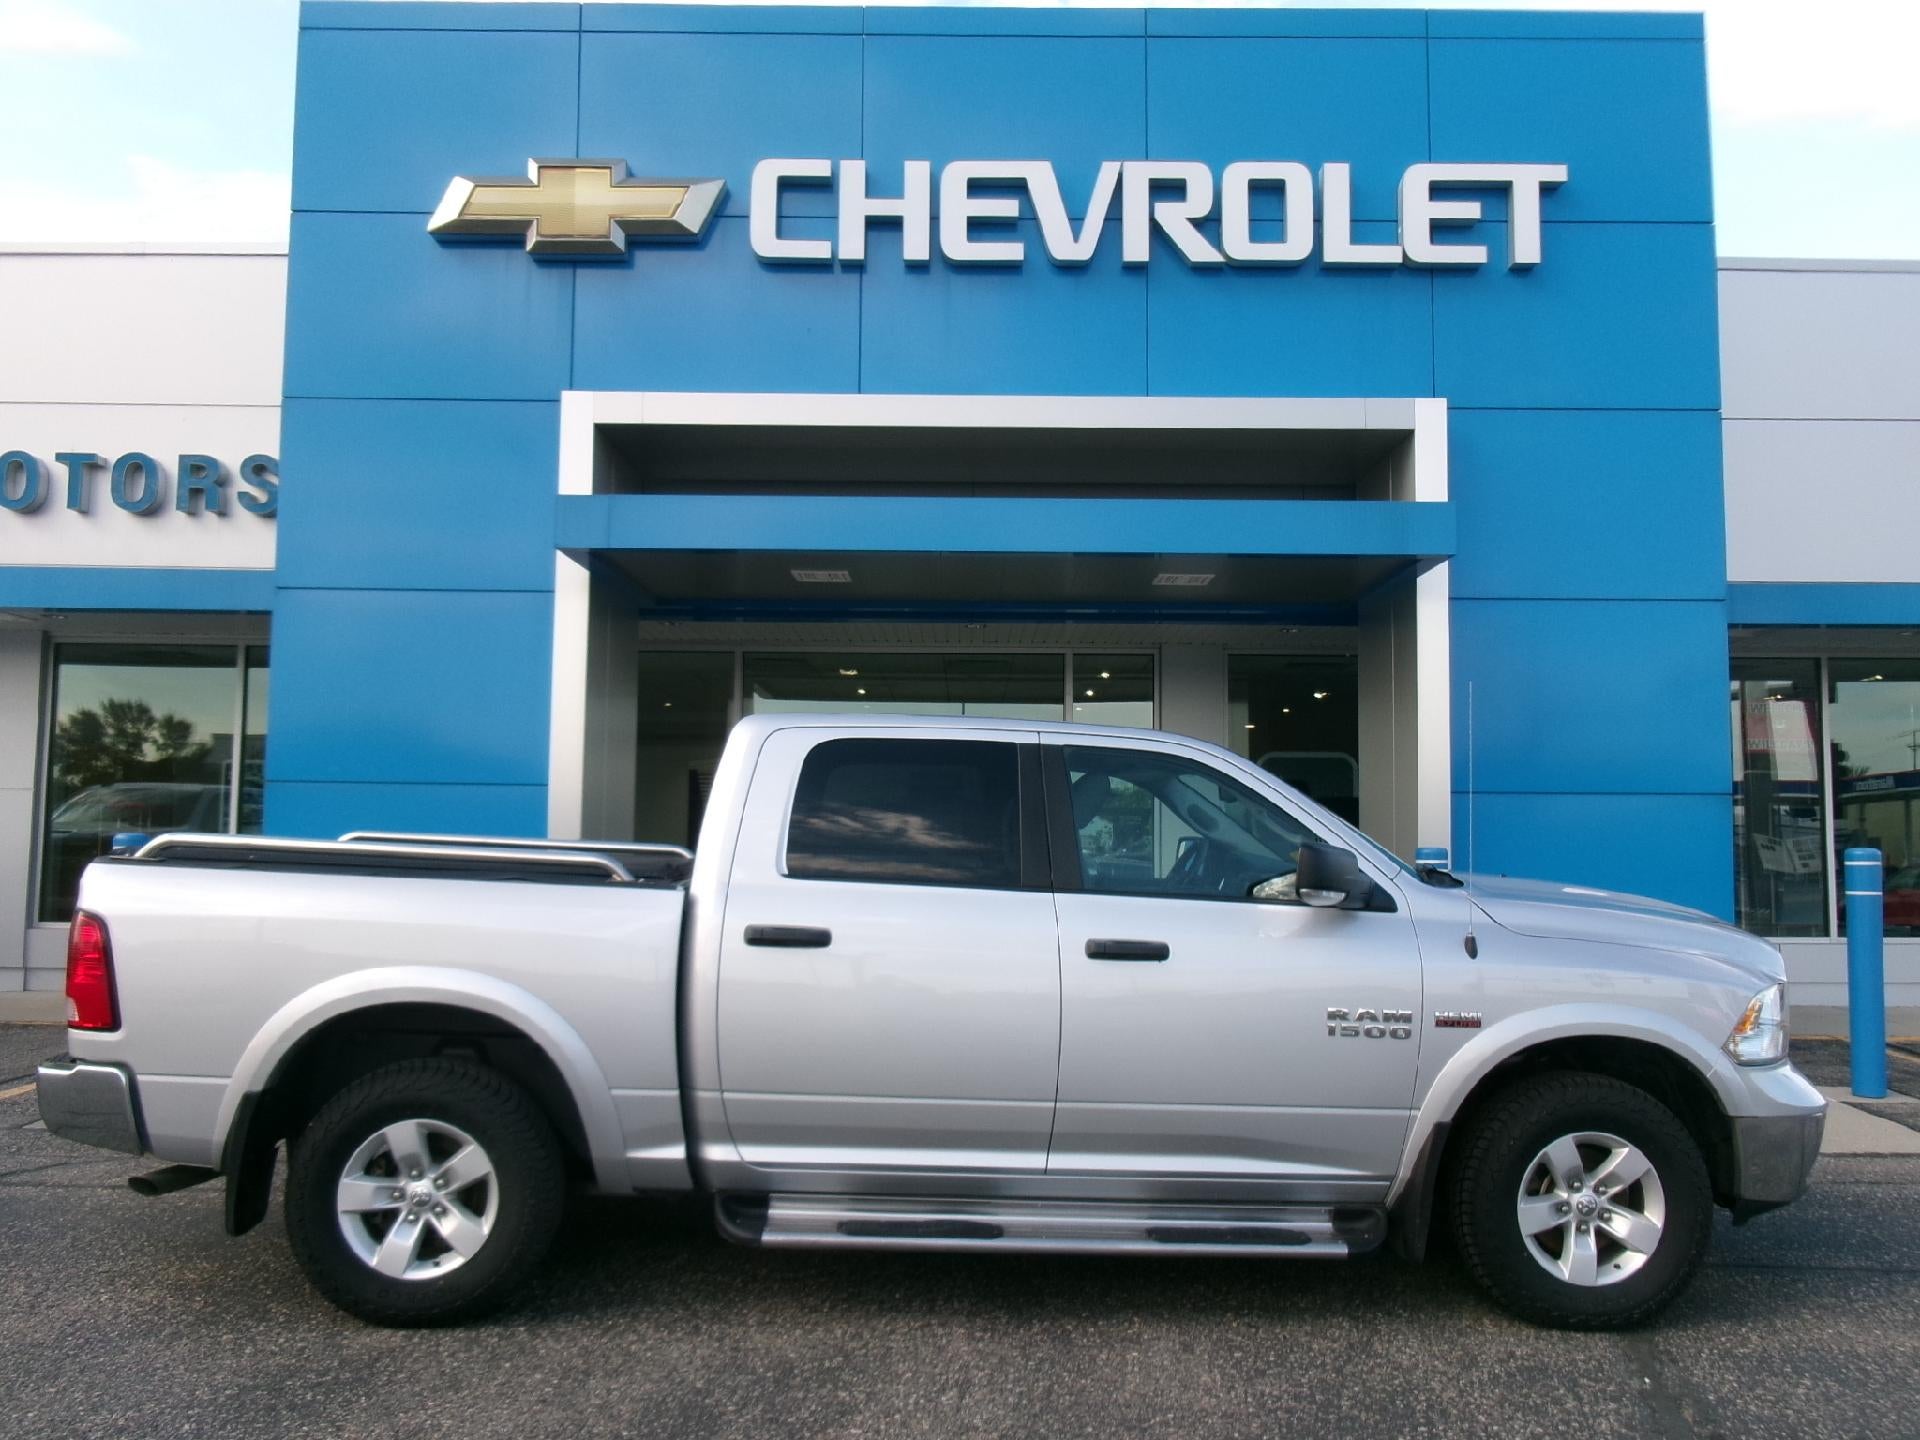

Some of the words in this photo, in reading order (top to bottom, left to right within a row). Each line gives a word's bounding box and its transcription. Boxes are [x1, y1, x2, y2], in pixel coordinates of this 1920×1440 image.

[750, 159, 1568, 268] CHEVROLET
[0, 450, 278, 516] OTORS
[1327, 1007, 1413, 1023] RAM
[1327, 1023, 1412, 1039] 1500
